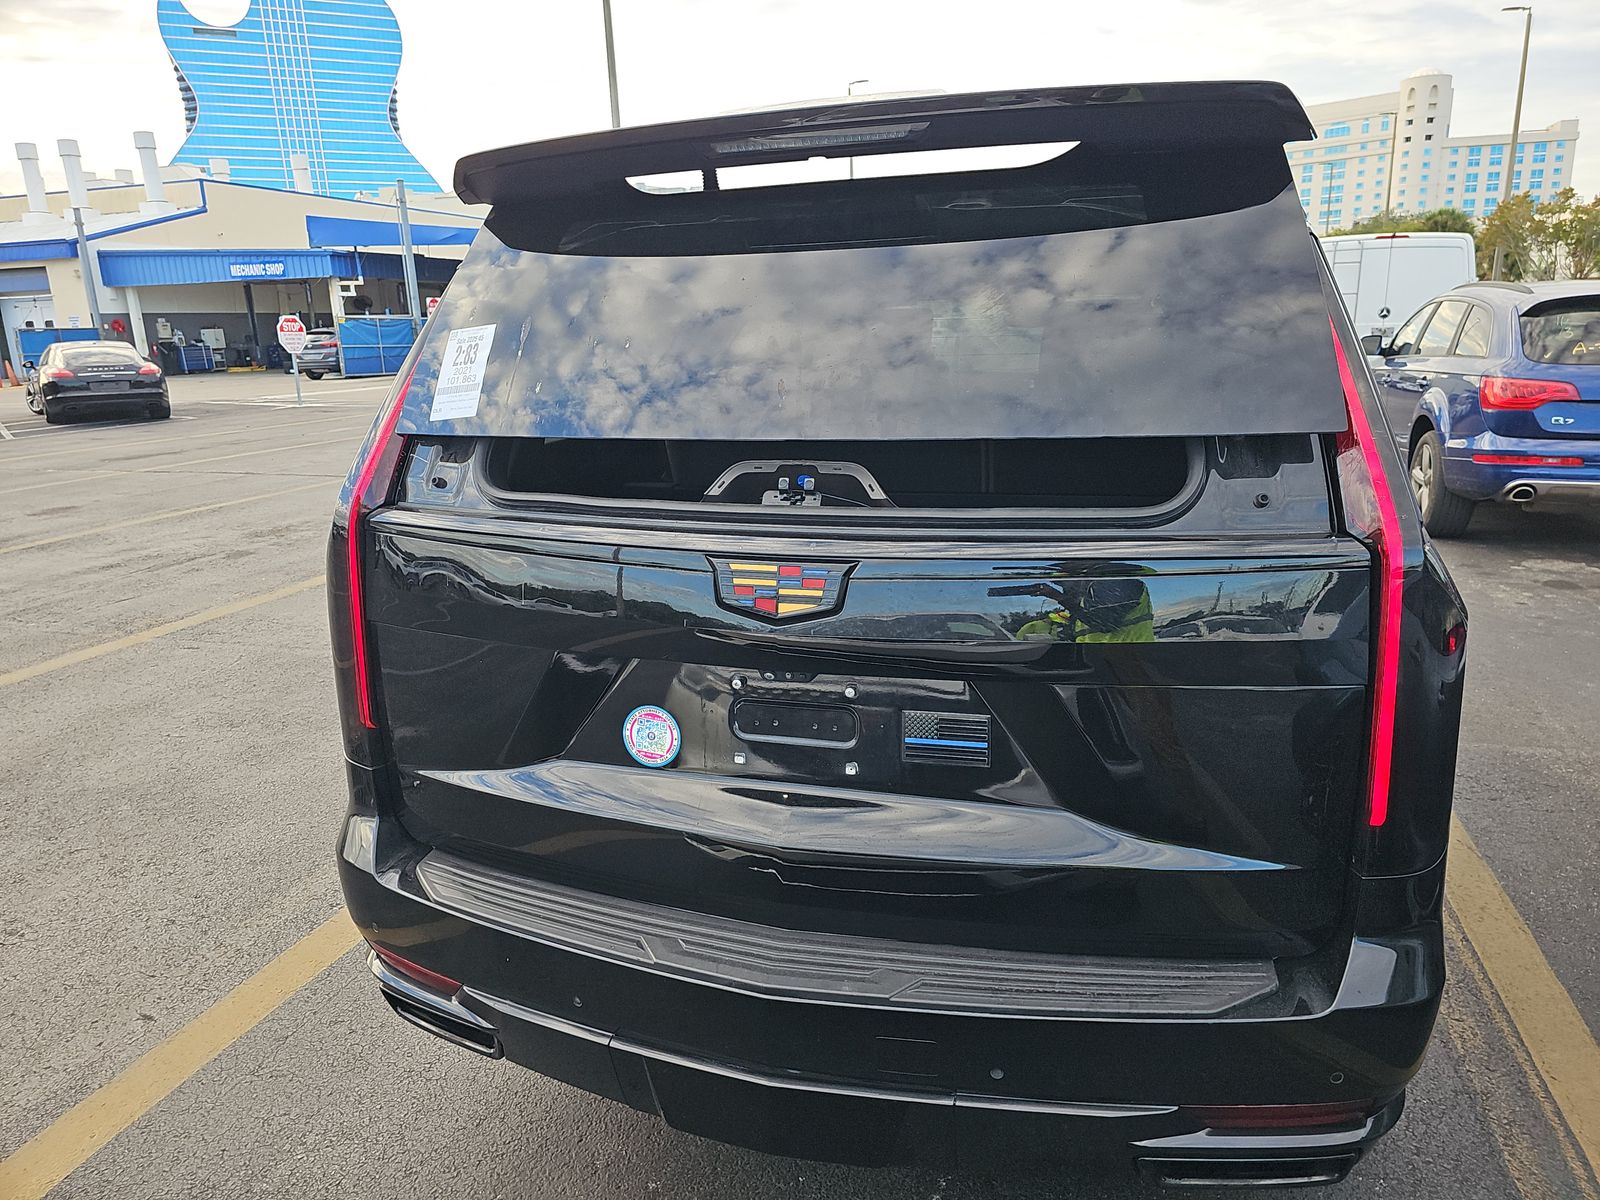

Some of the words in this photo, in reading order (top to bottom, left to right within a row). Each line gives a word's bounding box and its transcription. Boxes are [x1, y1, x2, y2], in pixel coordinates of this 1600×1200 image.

[230, 263, 265, 276] MECHANIC
[265, 263, 284, 275] SHOP
[282, 322, 300, 331] STOP
[452, 342, 479, 367] 2:83
[453, 366, 472, 376] 2021
[1551, 416, 1575, 425] Q7
